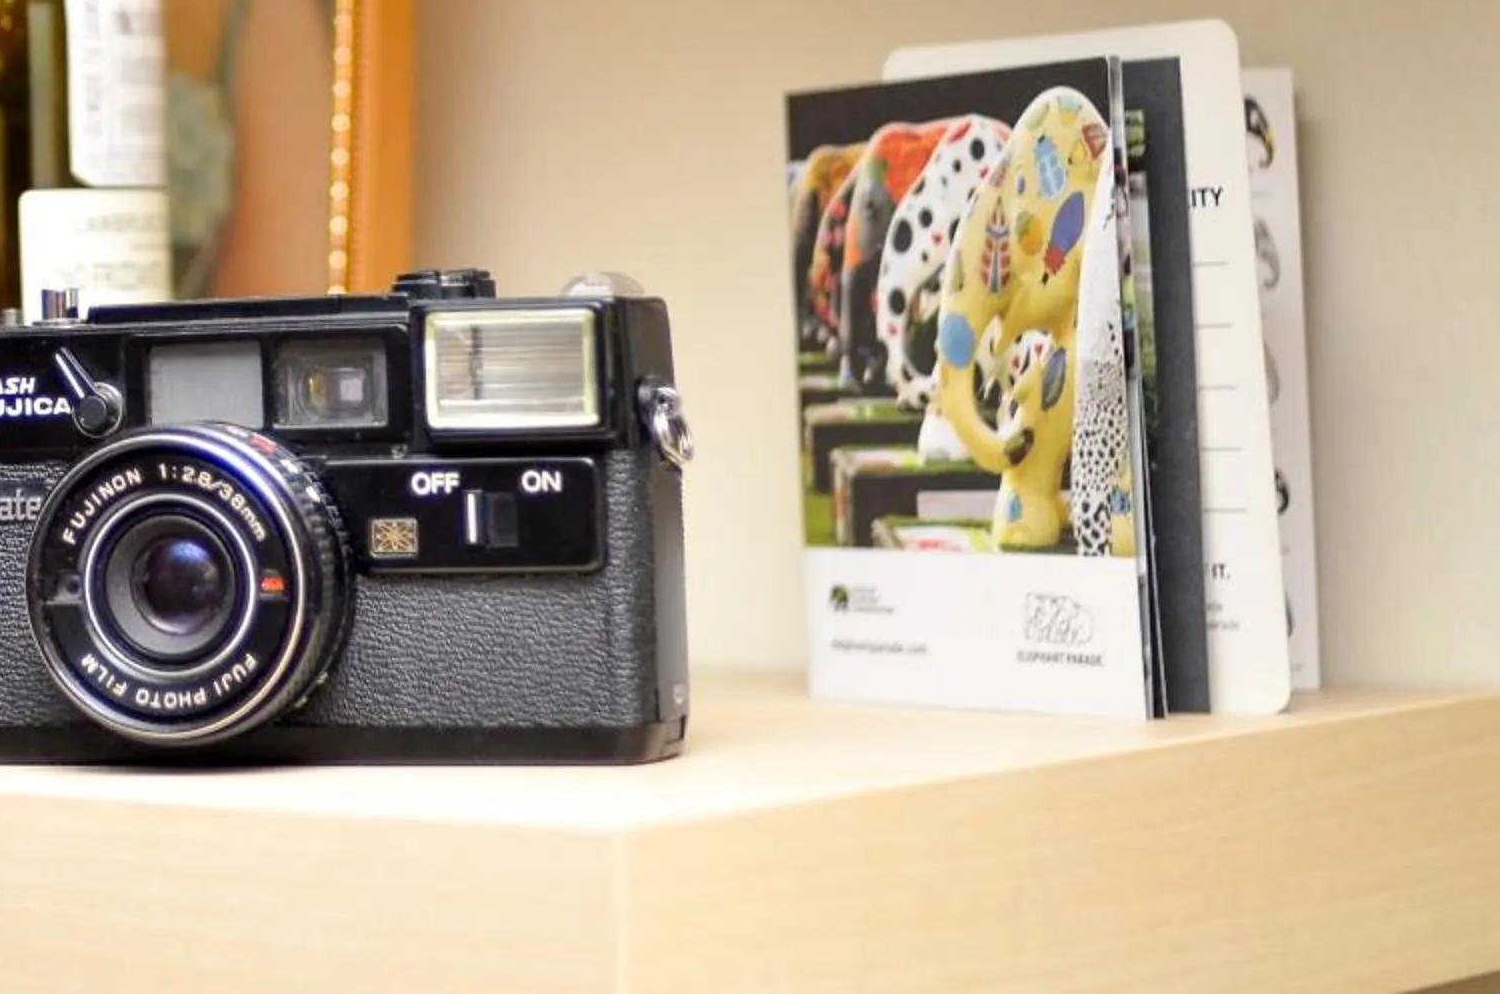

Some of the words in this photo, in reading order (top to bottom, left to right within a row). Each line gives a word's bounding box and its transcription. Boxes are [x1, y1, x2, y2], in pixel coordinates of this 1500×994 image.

[1190, 186, 1223, 207] ITY
[411, 471, 461, 496] OFF
[521, 470, 563, 493] ON
[62, 468, 142, 545] FUJINON
[81, 653, 128, 699] FILM
[213, 653, 258, 696] FUJI
[136, 687, 207, 709] PHOTO
